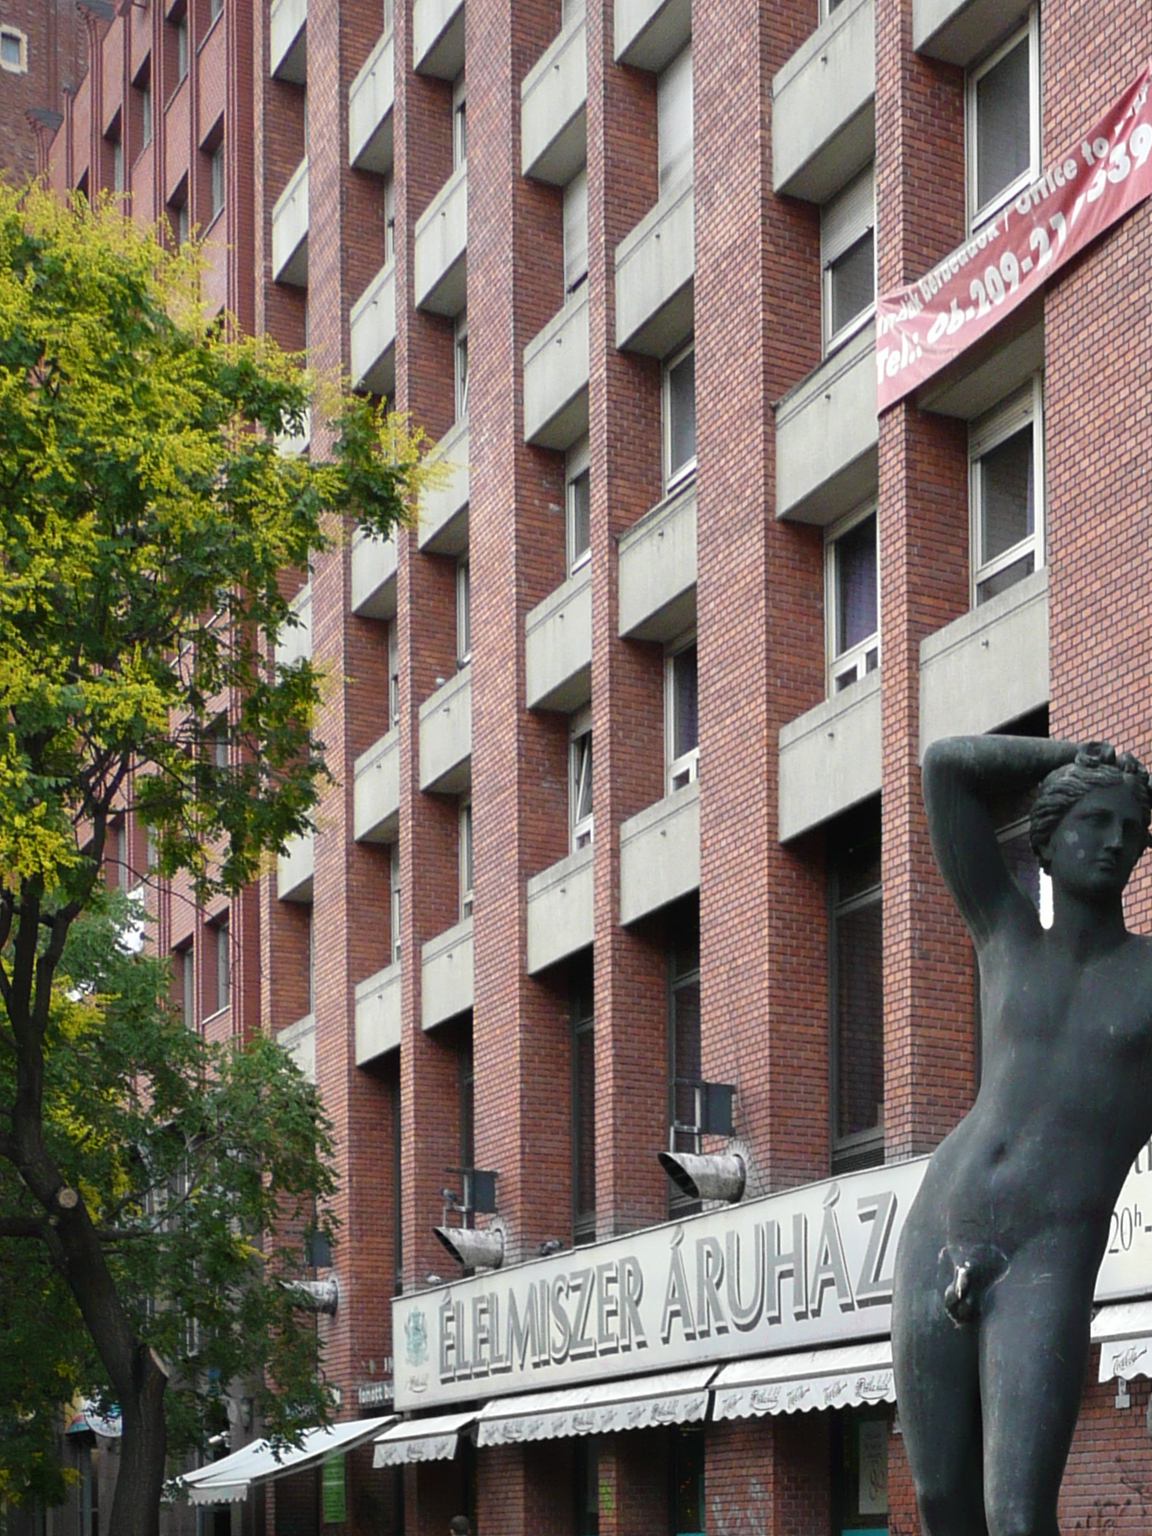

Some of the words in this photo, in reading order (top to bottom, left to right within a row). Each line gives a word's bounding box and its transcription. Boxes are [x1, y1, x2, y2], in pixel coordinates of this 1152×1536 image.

[1080, 136, 1110, 167] to
[438, 1254, 648, 1385] ÉLELMISZER
[660, 1182, 898, 1345] ÁRUHÁZ
